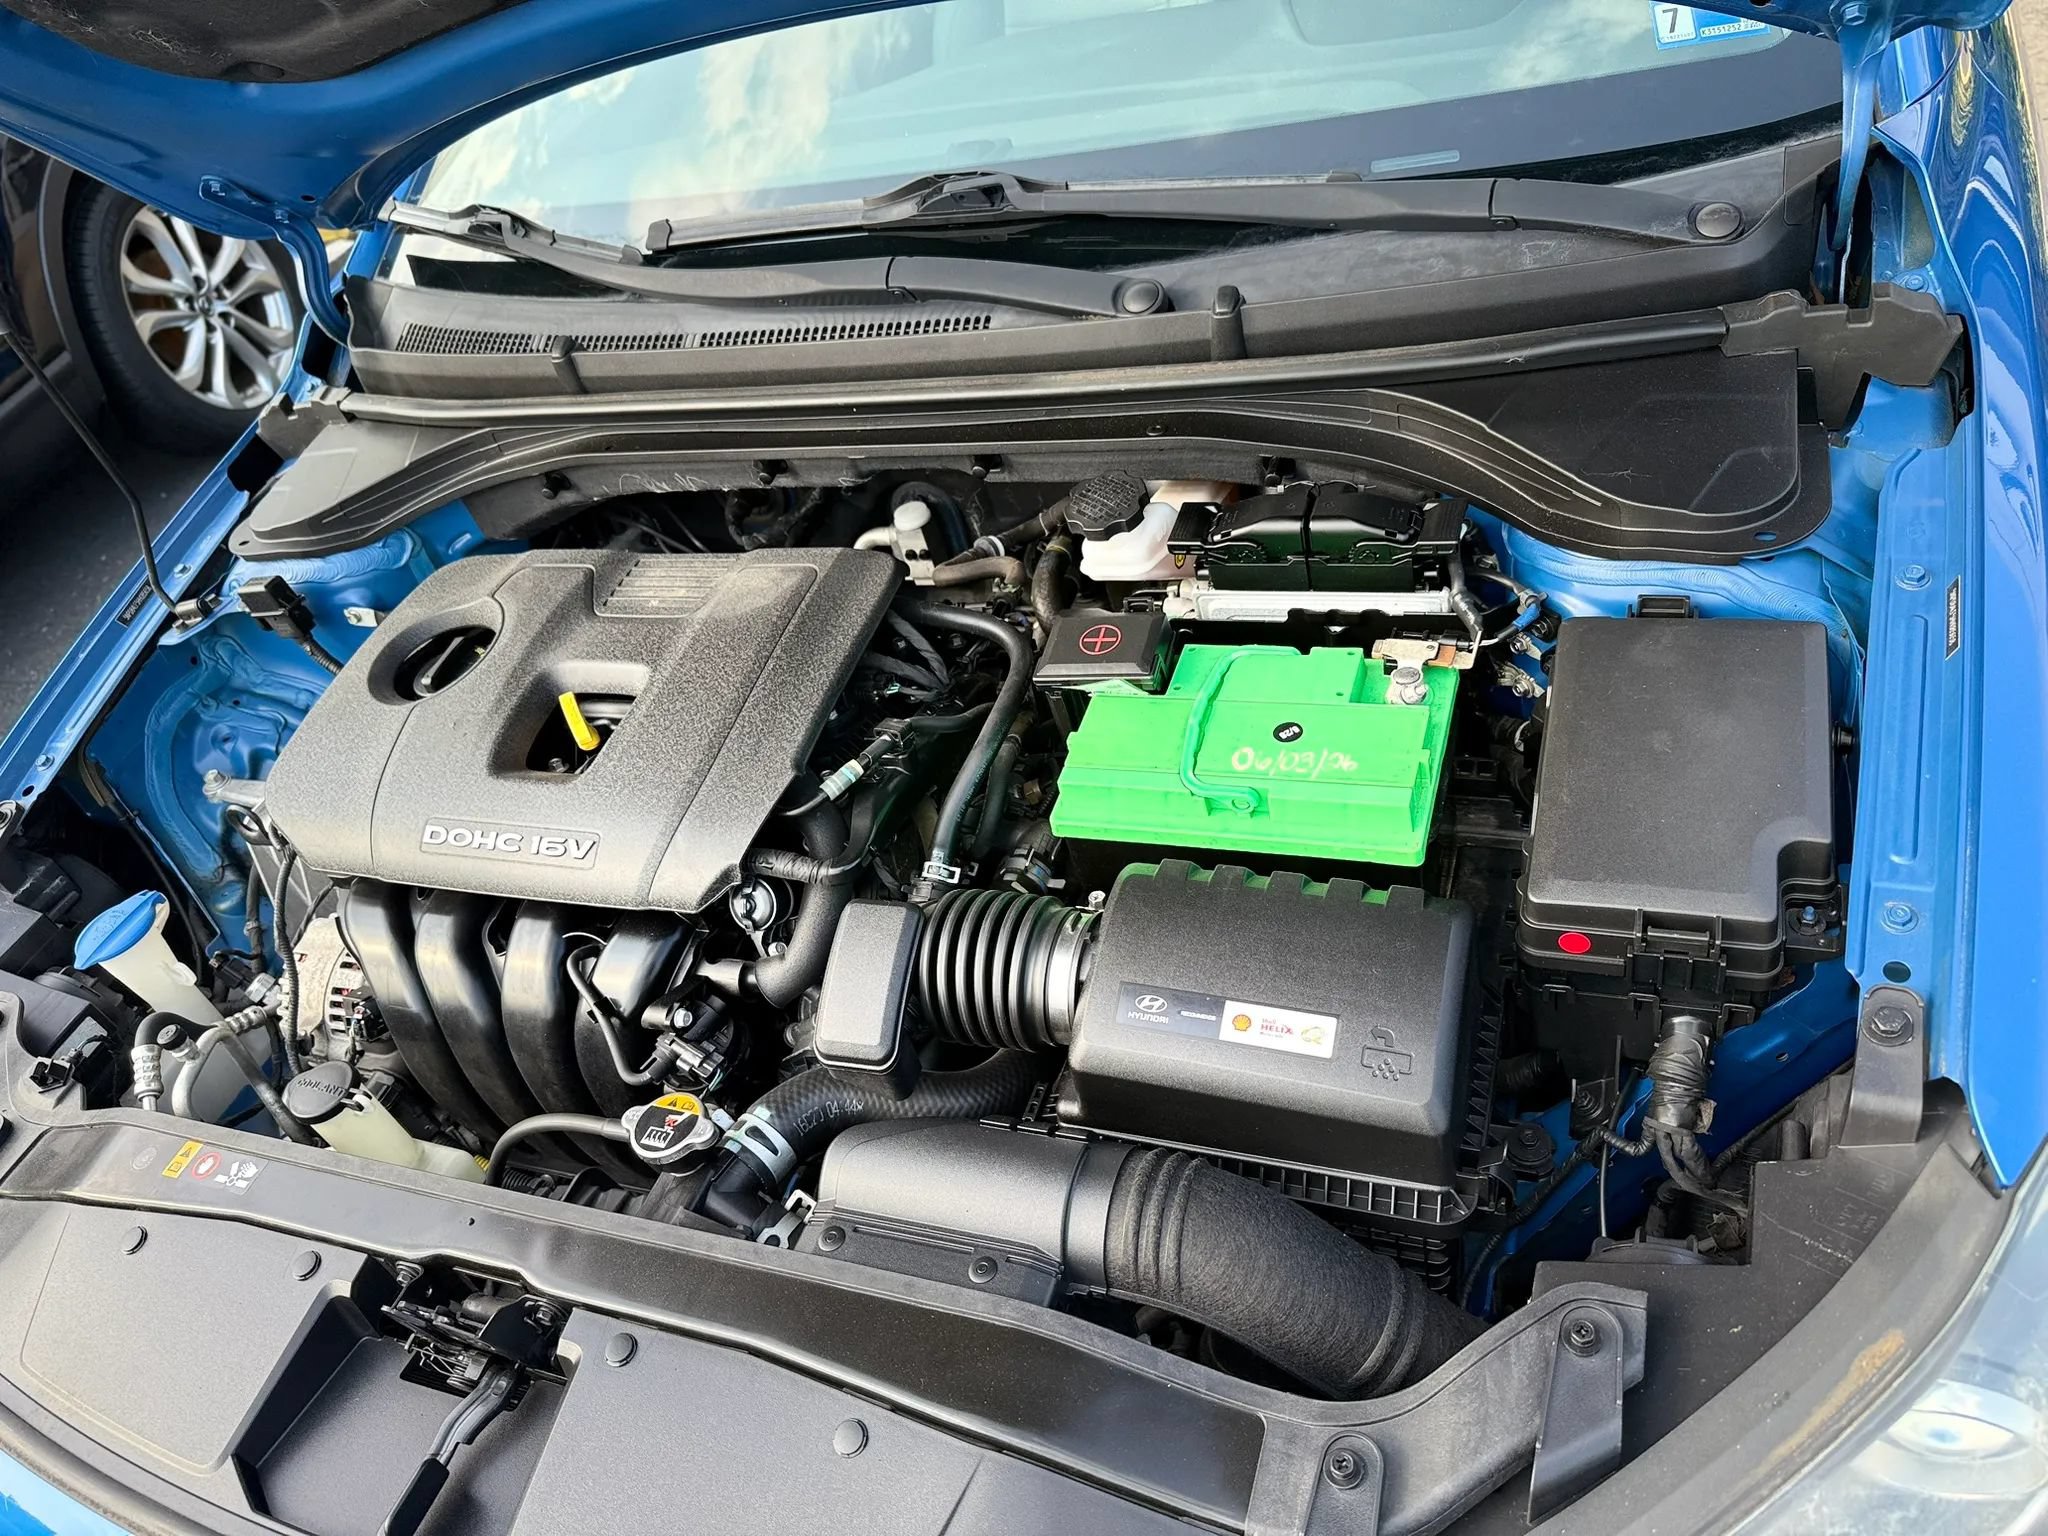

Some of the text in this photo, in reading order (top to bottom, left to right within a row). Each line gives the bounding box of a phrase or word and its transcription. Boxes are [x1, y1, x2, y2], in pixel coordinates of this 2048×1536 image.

[1662, 7, 1678, 34] 7
[422, 824, 597, 860] DOHC 16V
[1127, 1011, 1169, 1024] HYUNDAI
[1260, 1023, 1294, 1035] HELIX
[297, 1079, 344, 1097] COOLANT
